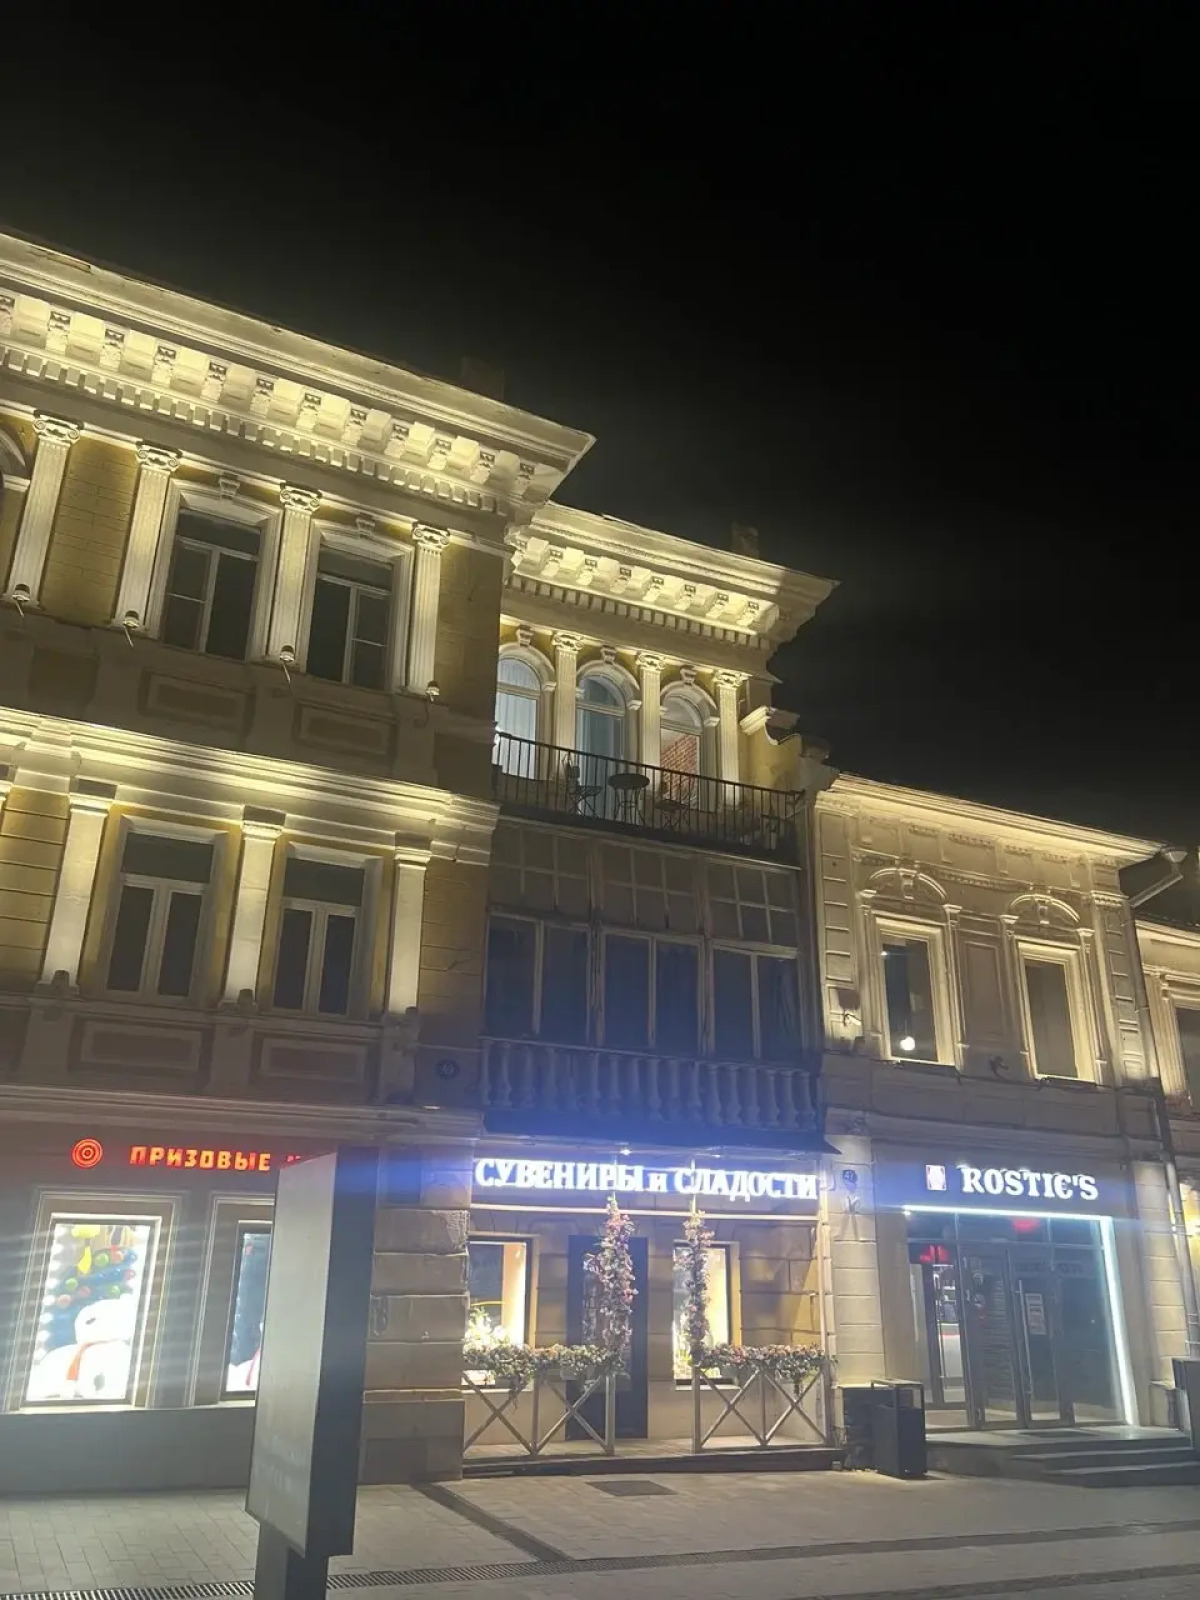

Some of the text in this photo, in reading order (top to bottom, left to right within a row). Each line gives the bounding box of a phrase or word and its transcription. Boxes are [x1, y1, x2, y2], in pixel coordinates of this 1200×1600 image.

[129, 1146, 272, 1172] ПРИЗОВЫЕ
[474, 1157, 643, 1192] СУВЕНИРЫ
[673, 1166, 818, 1202] СЛАДОСТИ
[960, 1166, 1099, 1201] ROSTIC'S
